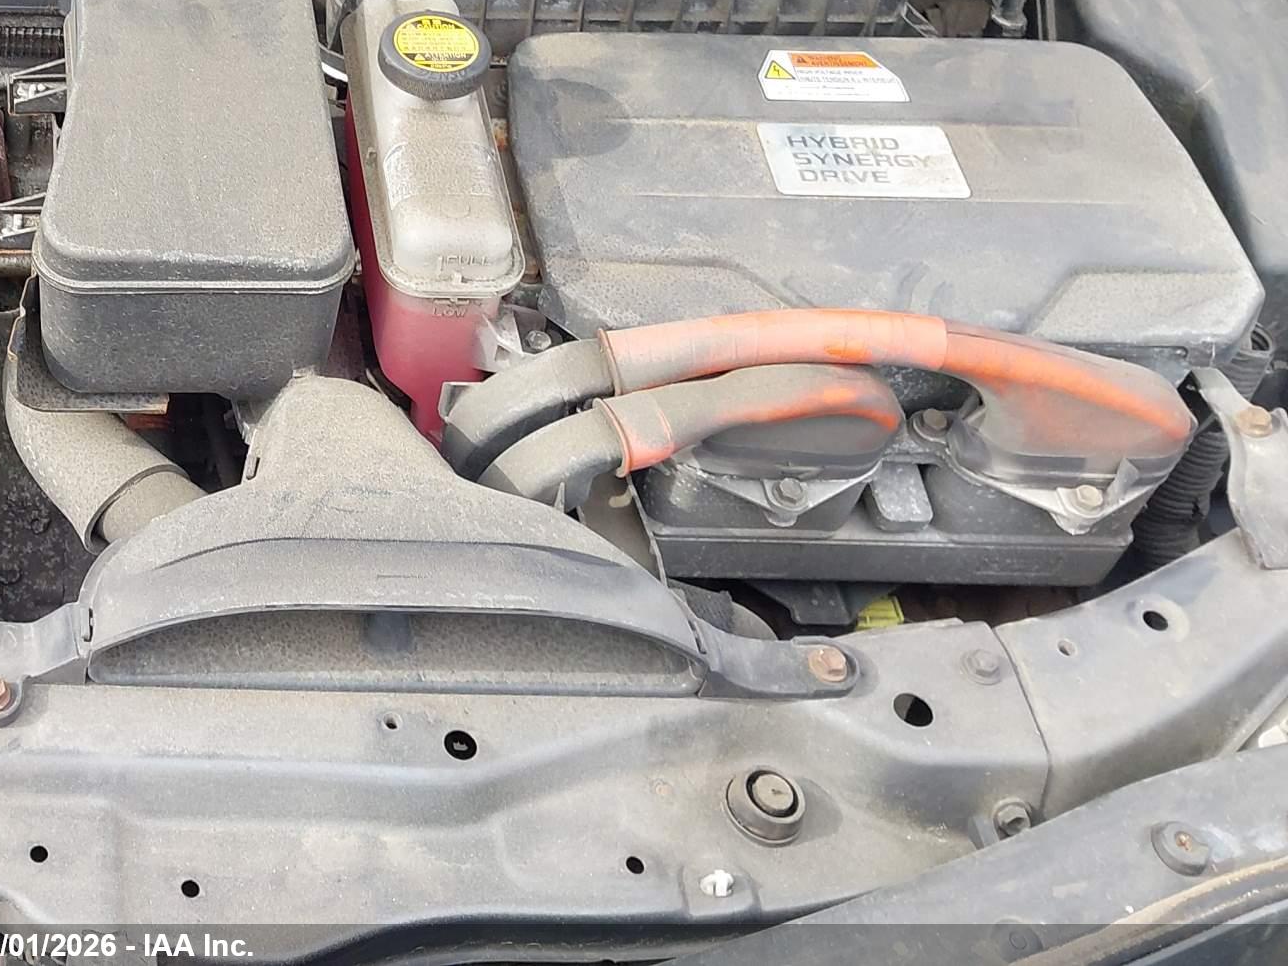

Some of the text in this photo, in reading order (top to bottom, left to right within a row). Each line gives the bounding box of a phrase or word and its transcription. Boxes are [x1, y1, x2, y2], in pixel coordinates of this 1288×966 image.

[786, 135, 900, 150] HYBRID
[793, 152, 933, 168] SYNERGY
[799, 169, 892, 184] DRIVE
